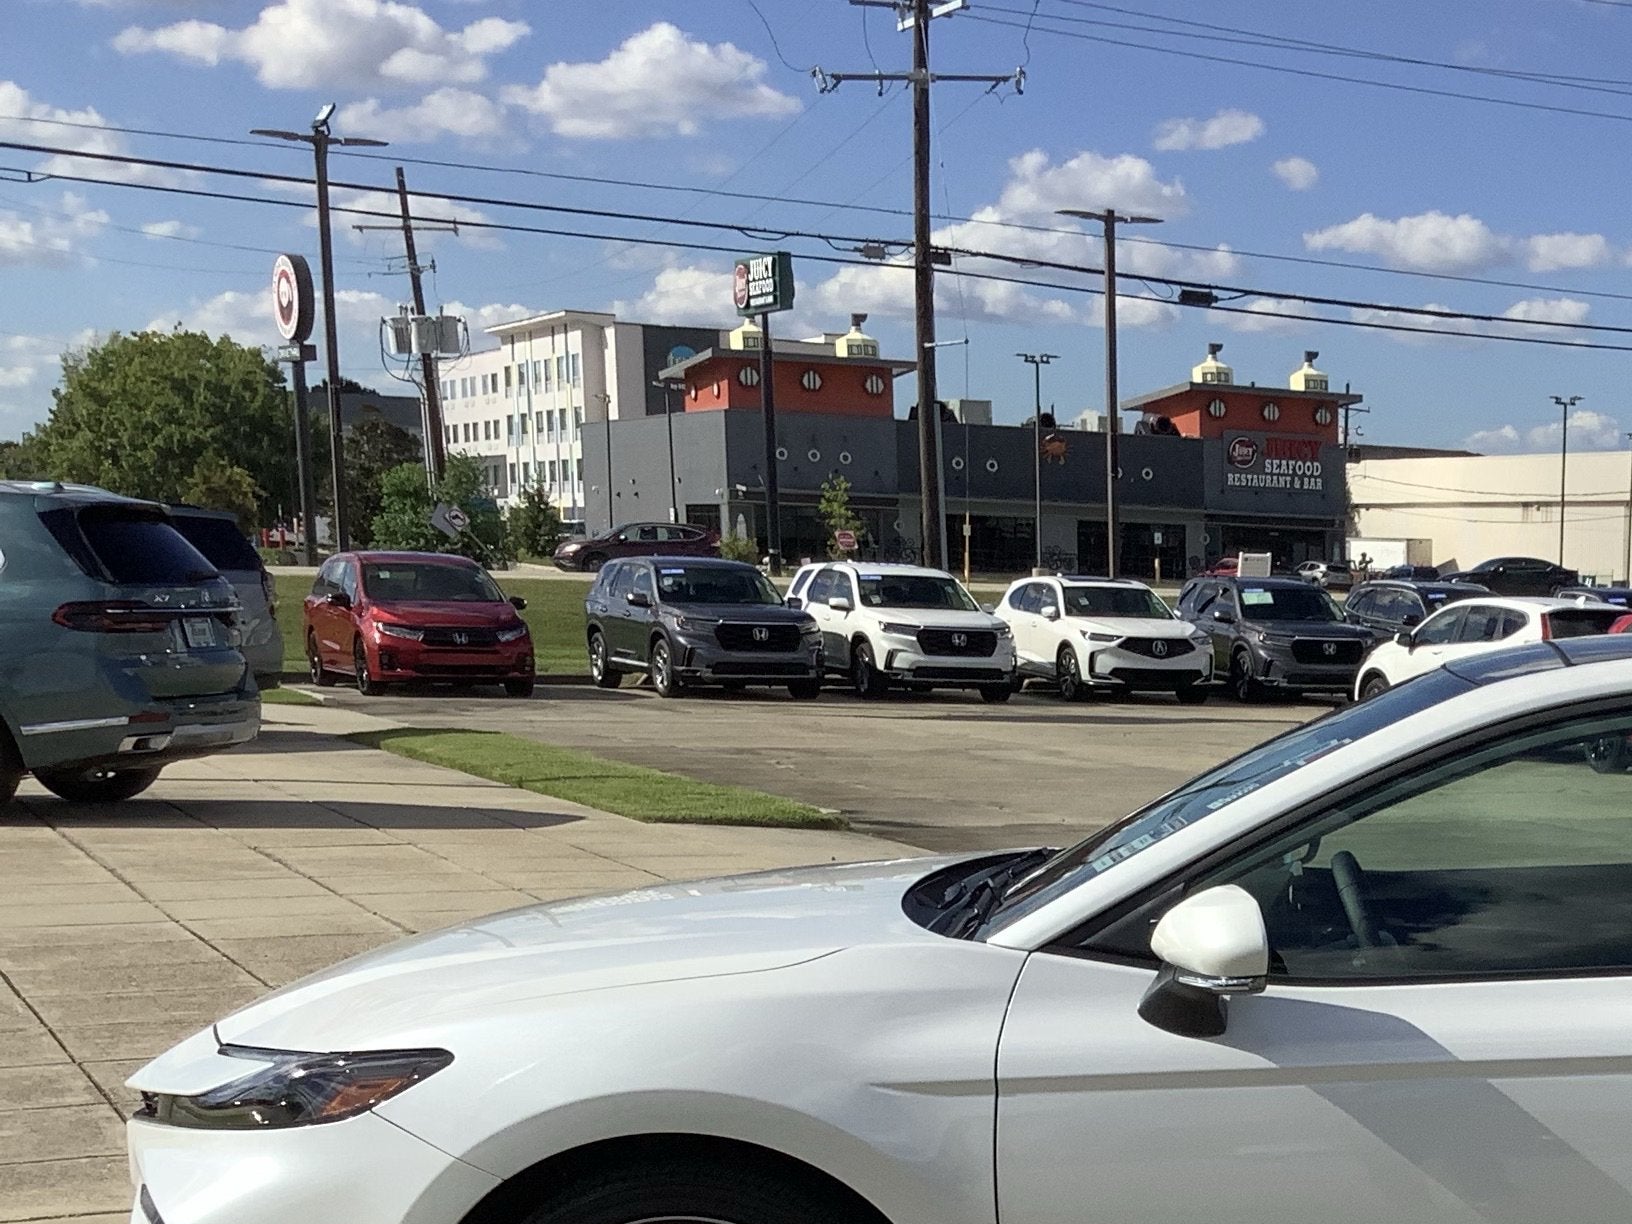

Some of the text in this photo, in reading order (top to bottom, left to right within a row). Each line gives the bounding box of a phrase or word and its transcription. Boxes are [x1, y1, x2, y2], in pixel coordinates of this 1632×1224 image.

[748, 256, 773, 281] JUICY
[1263, 437, 1322, 460] JUICY
[1264, 459, 1322, 476] SEAFOOD
[1227, 473, 1323, 491] RESTAURANT & BAR
